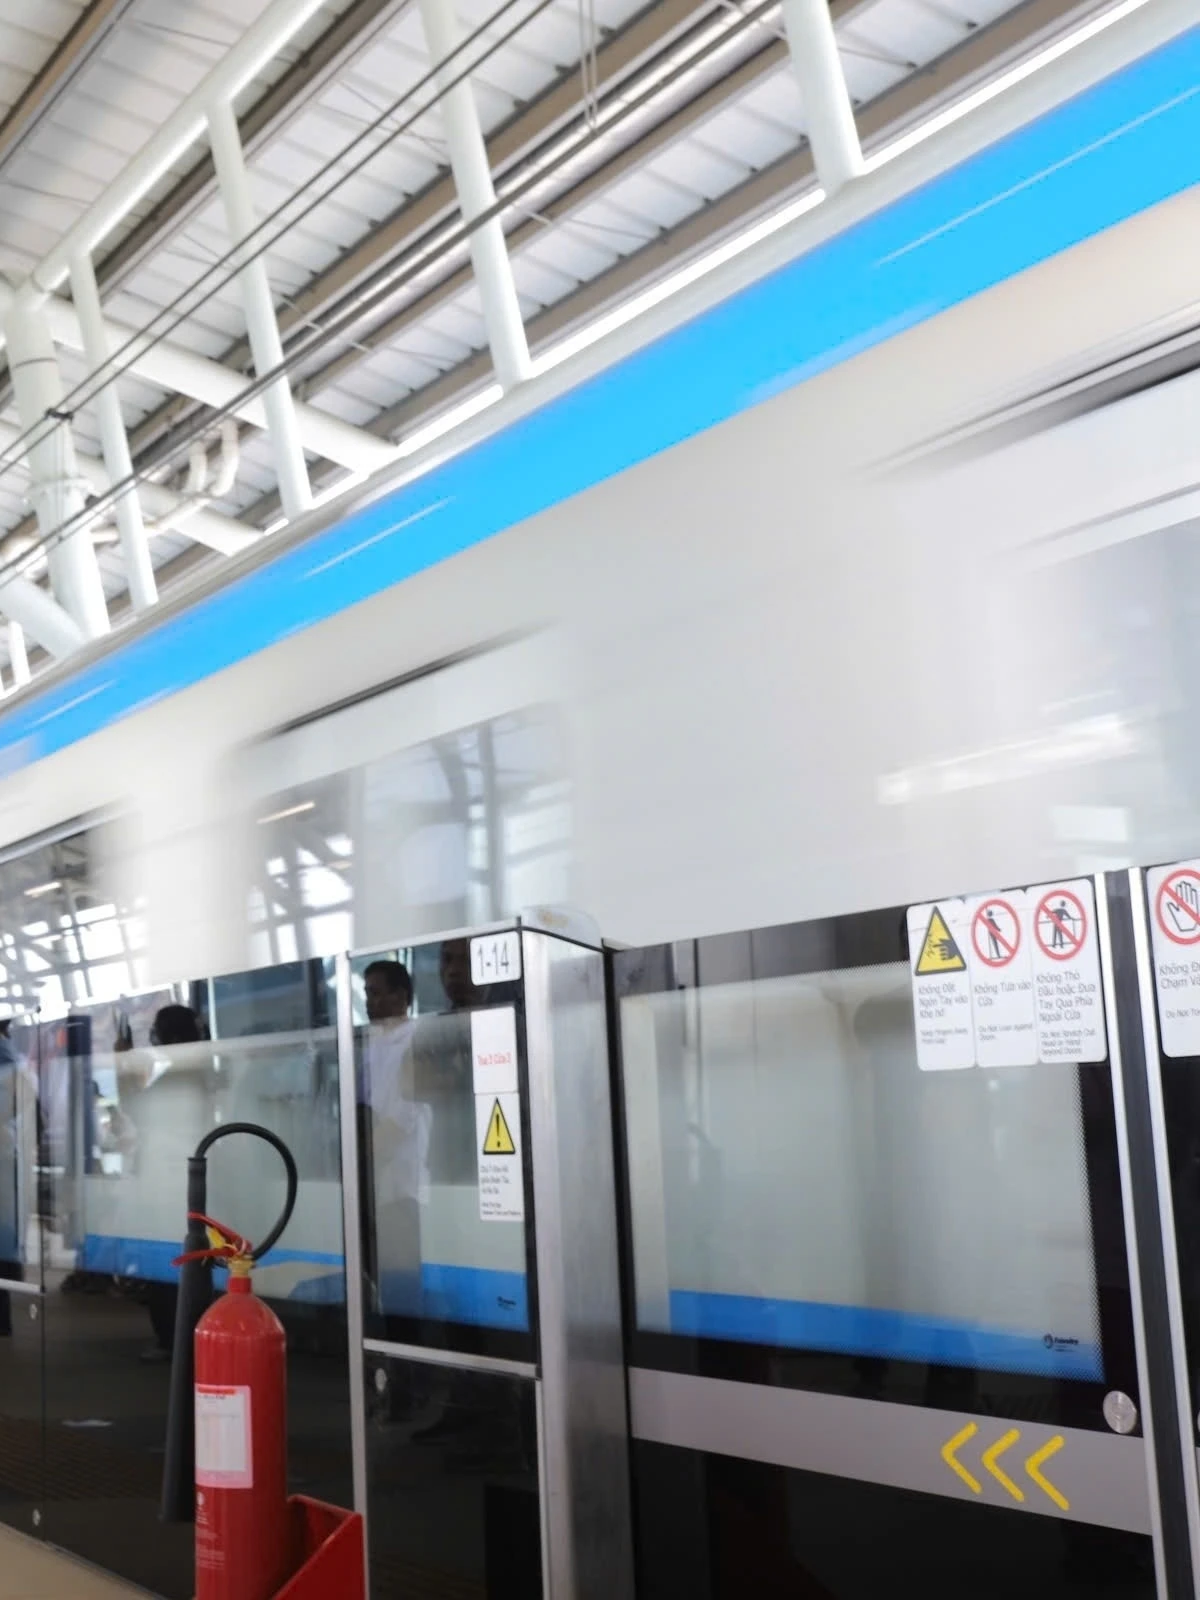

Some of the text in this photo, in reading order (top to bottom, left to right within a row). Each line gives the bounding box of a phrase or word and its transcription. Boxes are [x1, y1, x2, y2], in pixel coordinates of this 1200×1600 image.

[477, 940, 510, 977] 1-14
[1159, 963, 1189, 976] Không
[1036, 972, 1061, 984] Không
[1160, 977, 1187, 989] Chạm
[974, 983, 998, 994] Không
[1056, 998, 1073, 1010] Qua
